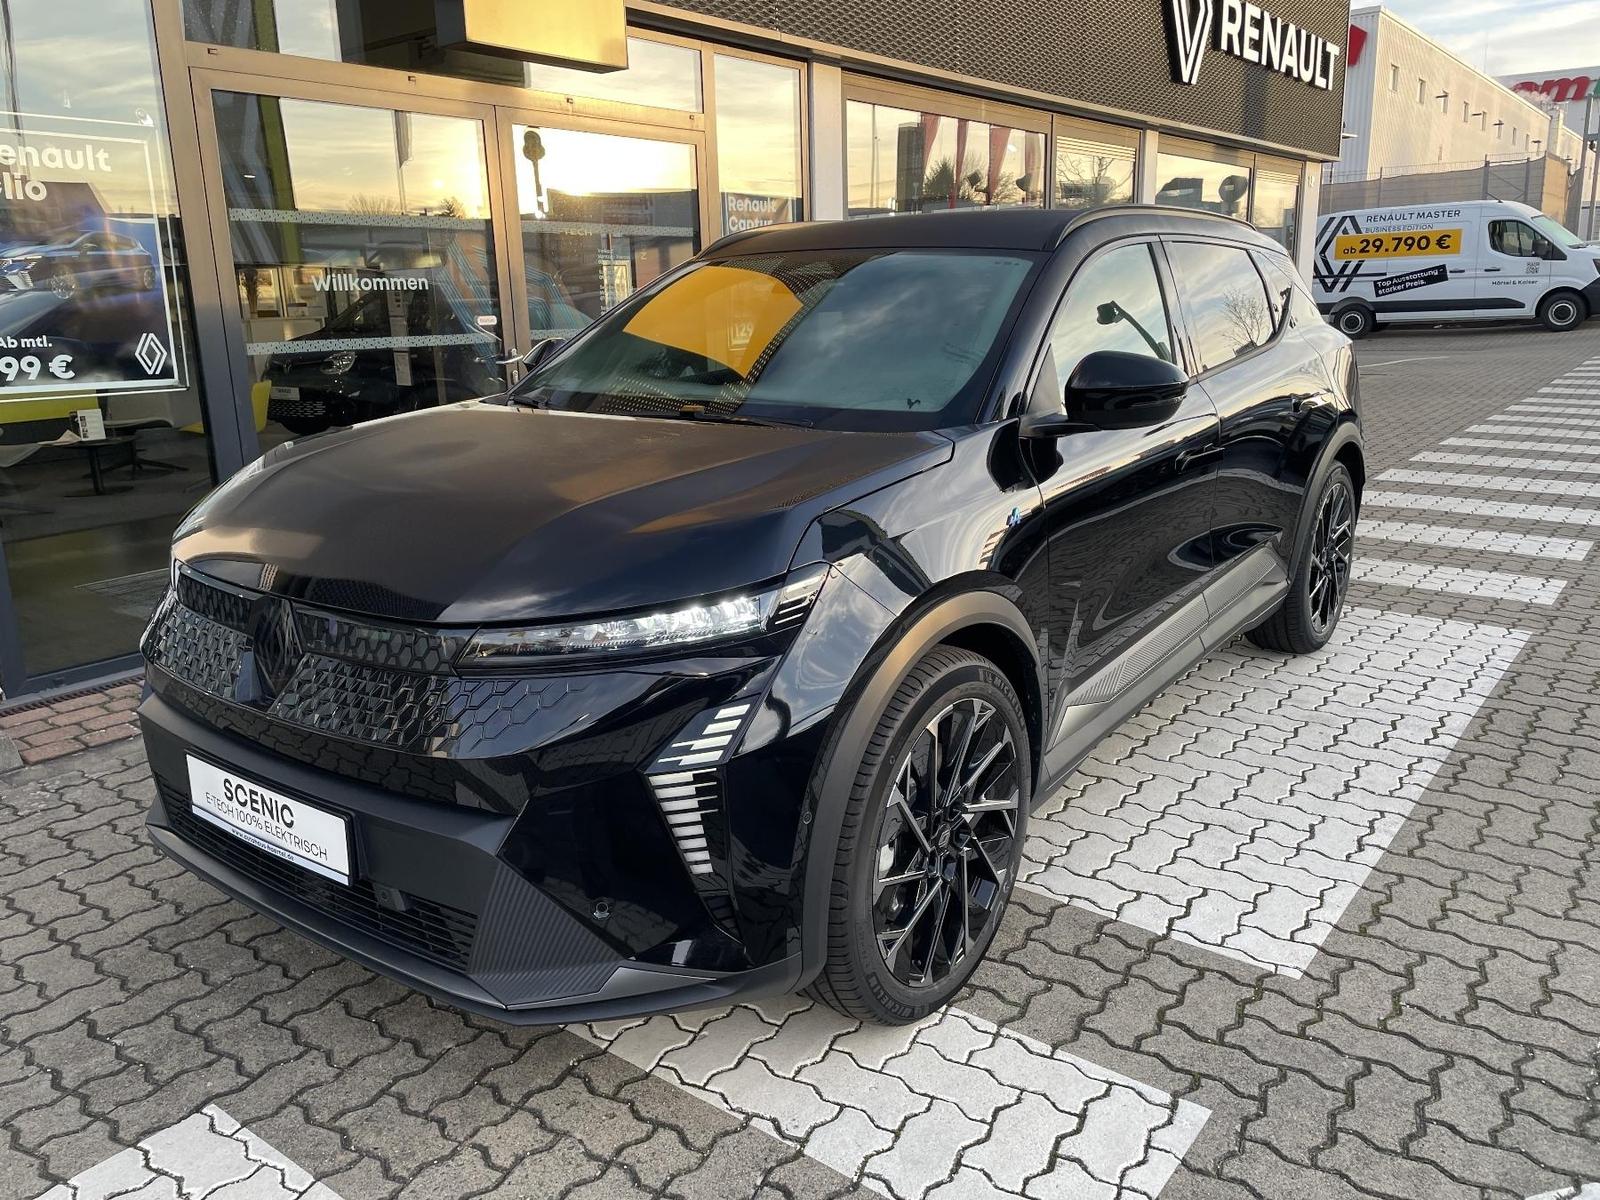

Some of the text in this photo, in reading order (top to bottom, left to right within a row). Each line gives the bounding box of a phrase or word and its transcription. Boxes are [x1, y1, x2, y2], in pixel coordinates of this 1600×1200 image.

[1220, 0, 1340, 91] RENAULT
[0, 144, 113, 172] enault
[0, 171, 47, 201] lio
[728, 196, 777, 213] Renault
[1366, 209, 1461, 223] RENAULT MASTER
[1365, 223, 1434, 234] BUSINESS EDITION
[1343, 234, 1452, 255] ab 29.790 €
[311, 273, 429, 292] Willkommen
[1377, 279, 1392, 288] Top
[1392, 268, 1438, 284] Ausstattung
[1378, 283, 1405, 295] starker
[0, 334, 53, 349] Ab mtl.
[0, 354, 76, 382] 99 €
[223, 778, 295, 829] SCENIC
[205, 792, 328, 861] E-TECH 100% ELEKTRISCH
